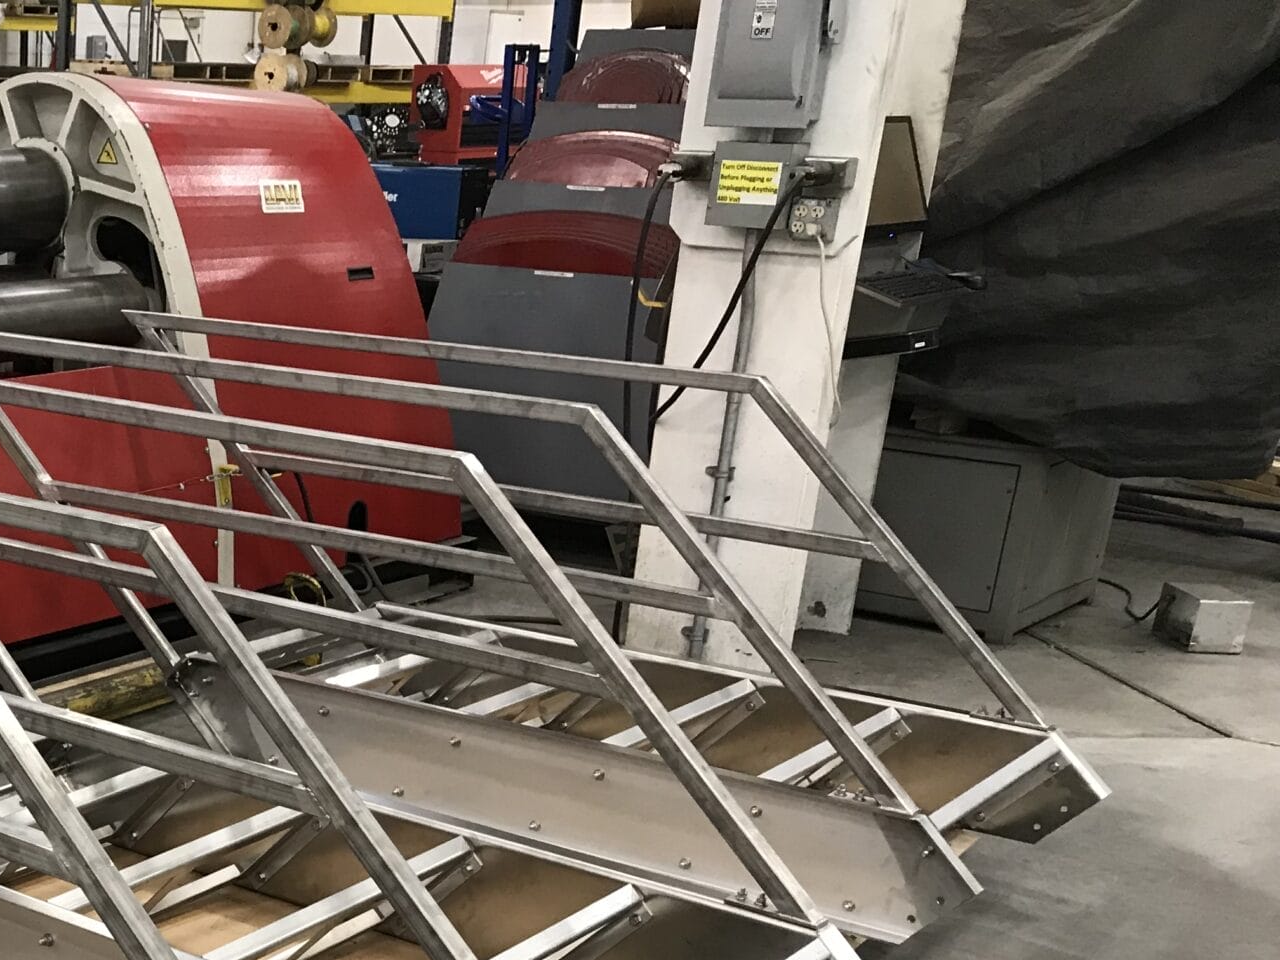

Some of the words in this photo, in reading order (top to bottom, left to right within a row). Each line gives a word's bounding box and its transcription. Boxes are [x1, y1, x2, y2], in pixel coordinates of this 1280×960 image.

[754, 27, 771, 36] OFF
[747, 164, 779, 172] Disconnect
[741, 174, 765, 183] Plugging
[751, 186, 778, 194] Anything
